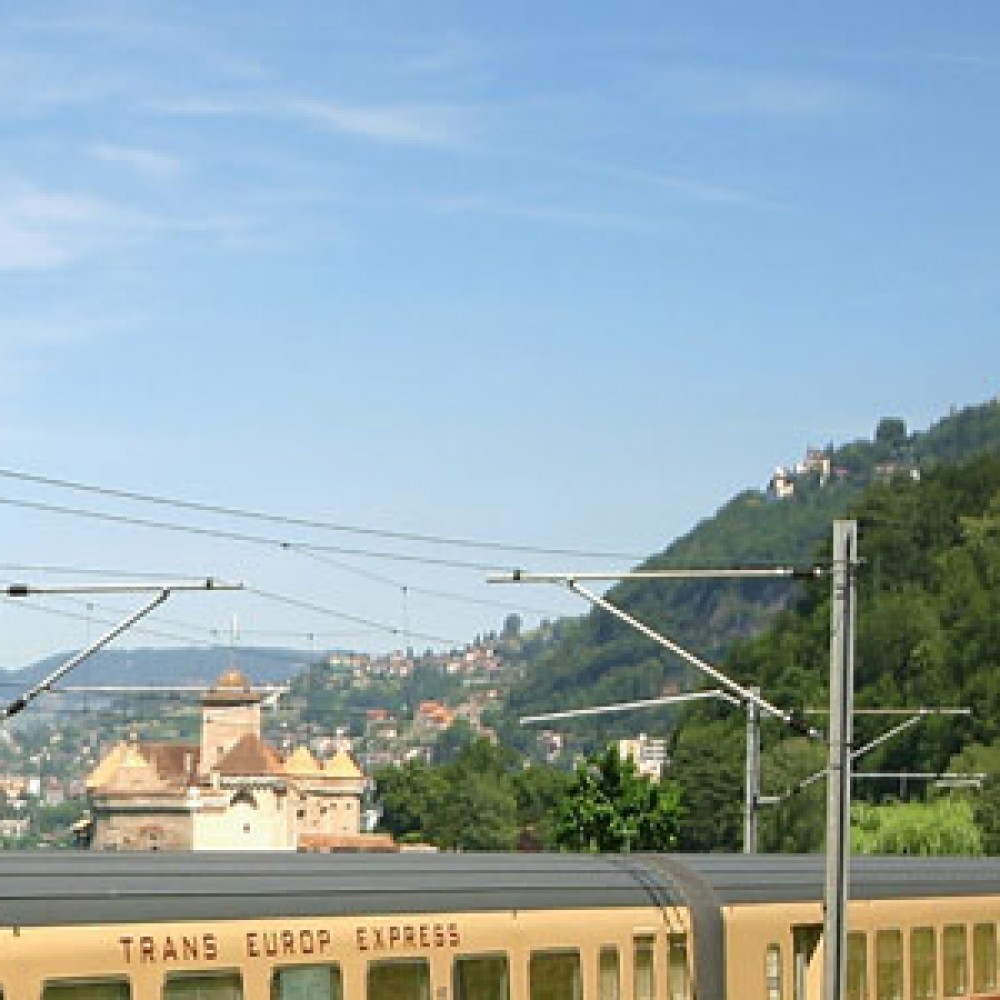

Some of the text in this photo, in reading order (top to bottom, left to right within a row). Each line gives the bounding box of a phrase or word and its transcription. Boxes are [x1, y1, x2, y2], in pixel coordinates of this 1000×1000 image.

[120, 923, 460, 963] TRANS EUROP EXPRESS
